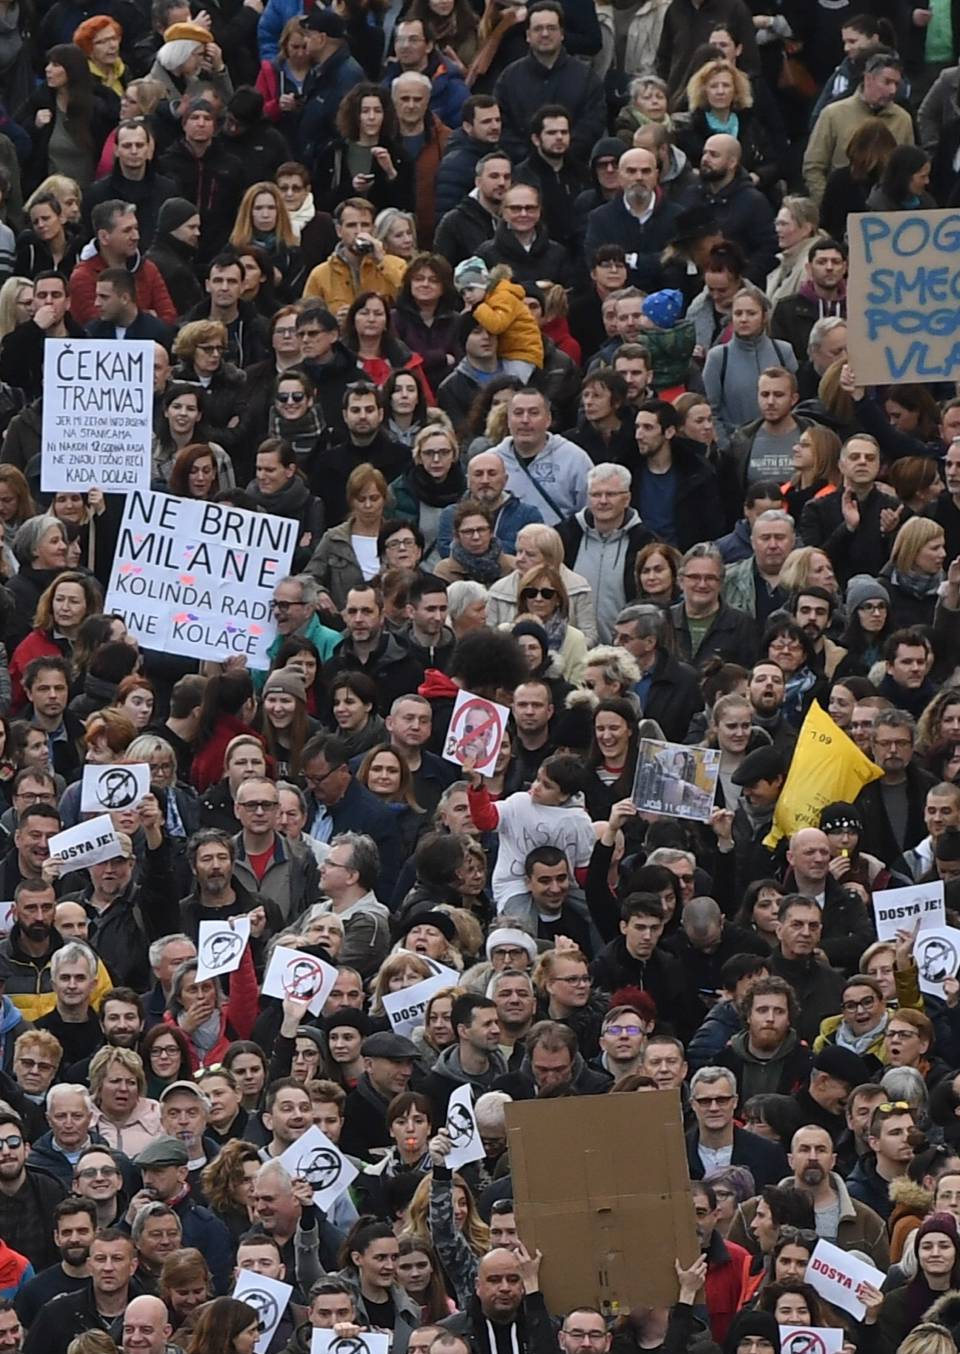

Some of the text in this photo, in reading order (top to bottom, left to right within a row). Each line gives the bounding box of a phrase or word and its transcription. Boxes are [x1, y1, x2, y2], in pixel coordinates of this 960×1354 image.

[56, 350, 143, 382] ČEKAM
[57, 386, 144, 413] TRAMVAJ
[63, 429, 77, 438] NA
[52, 455, 65, 465] NE
[66, 468, 138, 484] KADA DOLAZI
[127, 492, 294, 554] NE BRINI
[118, 528, 278, 590] MILANE
[114, 572, 213, 611] KOLINDA
[172, 617, 259, 656] KOLAČE
[95, 832, 115, 848] JE!
[878, 898, 942, 921] DOSTA JE!
[392, 1000, 427, 1024] DOST
[811, 1257, 853, 1289] DOSTA
